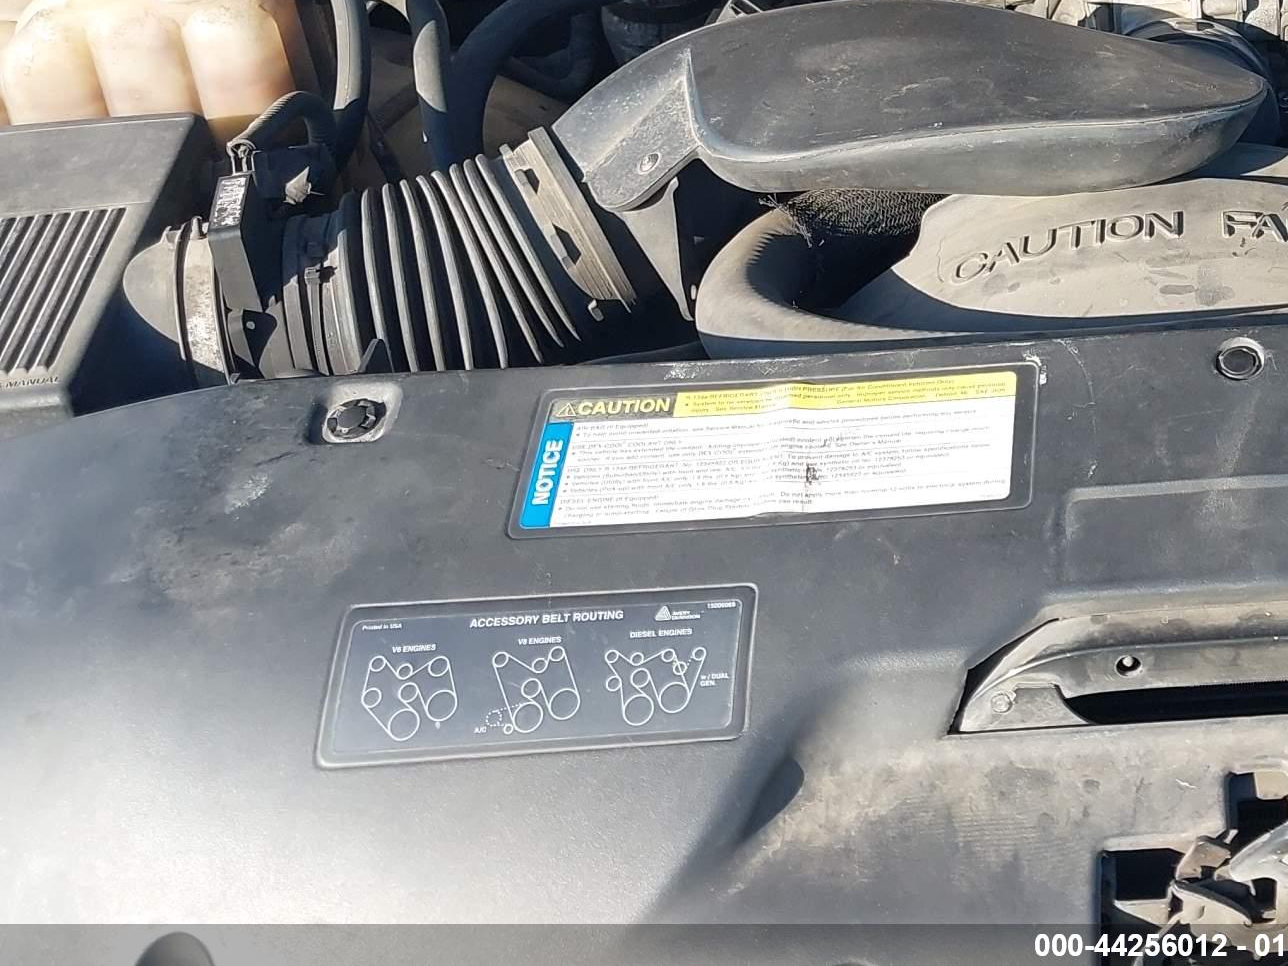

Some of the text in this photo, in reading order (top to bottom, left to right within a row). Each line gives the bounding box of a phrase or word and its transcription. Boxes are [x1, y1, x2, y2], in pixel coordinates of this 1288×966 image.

[949, 210, 1185, 284] CAUTION
[577, 397, 671, 417] CAUTION
[531, 438, 564, 506] NOTICE
[389, 622, 403, 630] USA
[469, 610, 625, 629] ACCESSORY BELT ROUTING
[528, 636, 562, 645] ENGINES
[629, 628, 693, 639] DIESEL ENGINES
[401, 643, 437, 653] ENGINES
